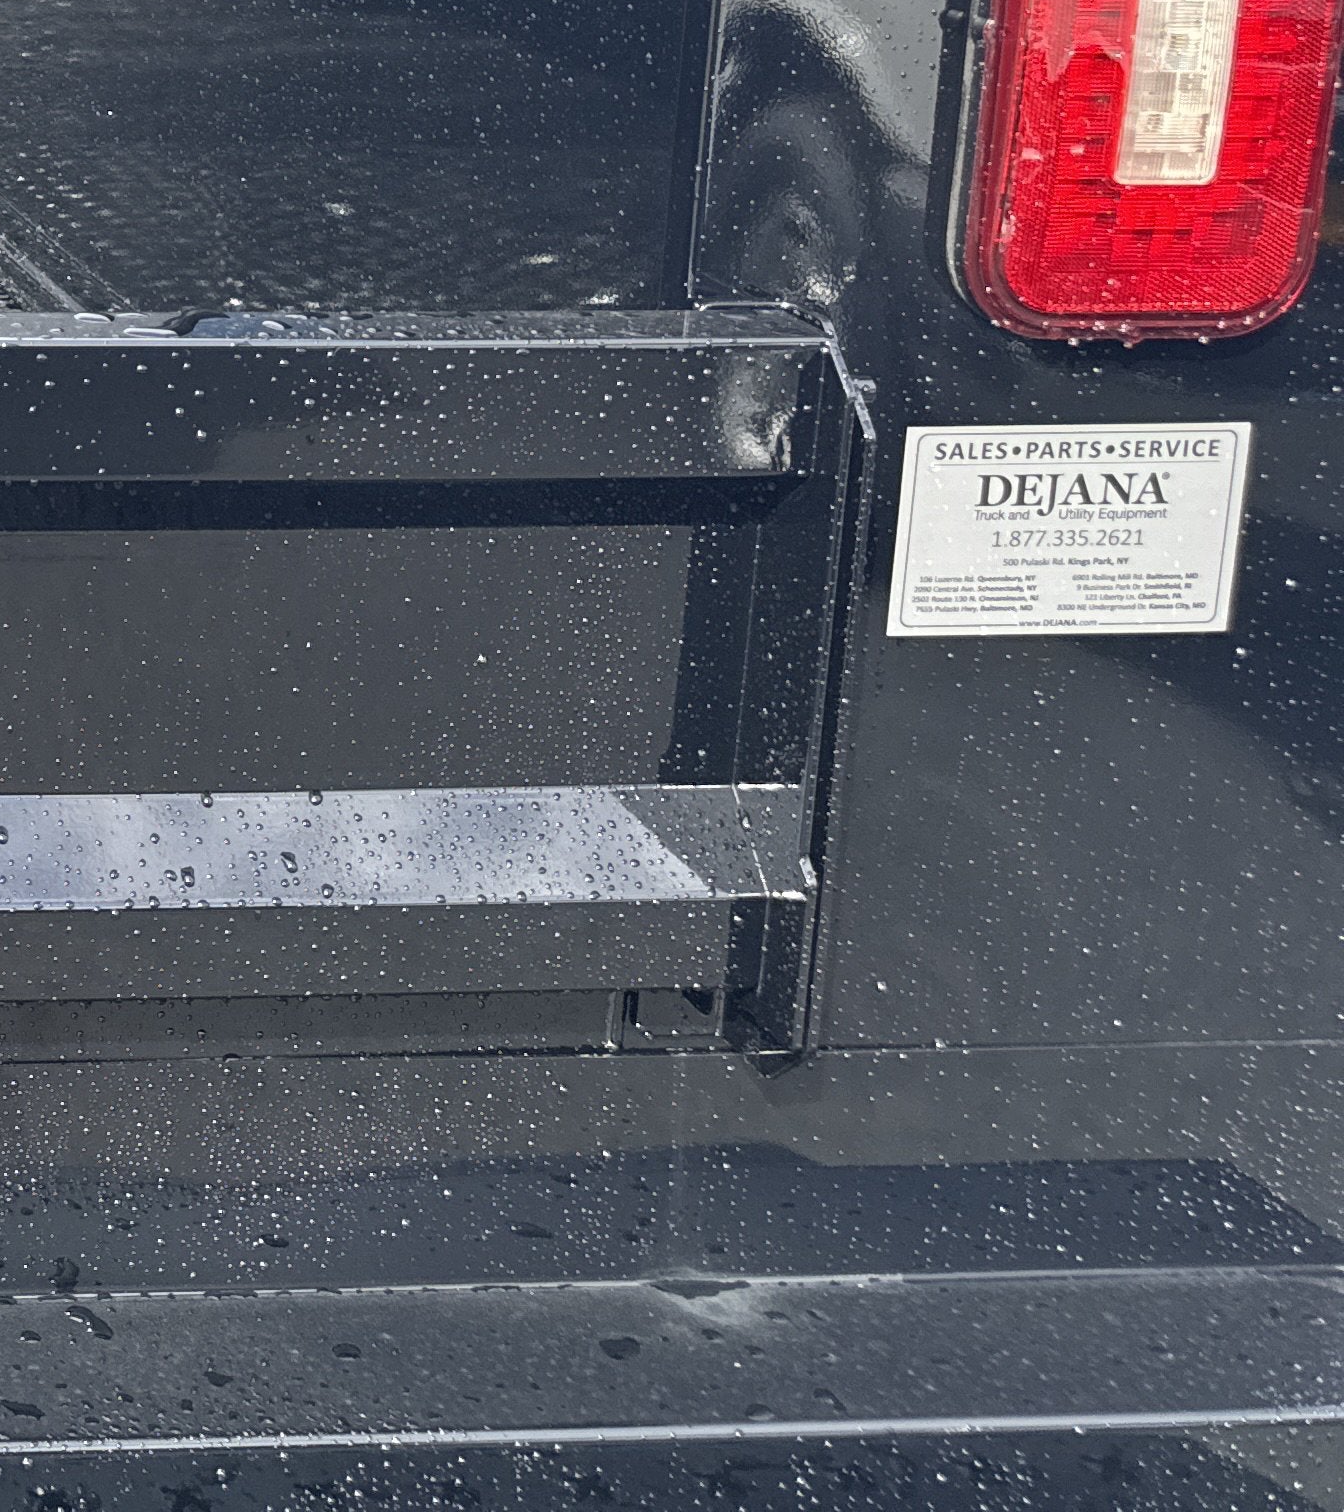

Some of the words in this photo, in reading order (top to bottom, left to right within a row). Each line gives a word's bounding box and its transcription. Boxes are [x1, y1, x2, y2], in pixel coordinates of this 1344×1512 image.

[974, 472, 1169, 516] DEJANA
[975, 509, 1005, 521] Truck
[1008, 509, 1030, 521] and
[1058, 508, 1095, 522] Utility
[1098, 508, 1168, 522] Equipment
[991, 529, 1144, 548] 1.877.335.2621
[1002, 558, 1019, 567] 500
[1068, 558, 1090, 567] Kings
[1117, 557, 1129, 565] NY
